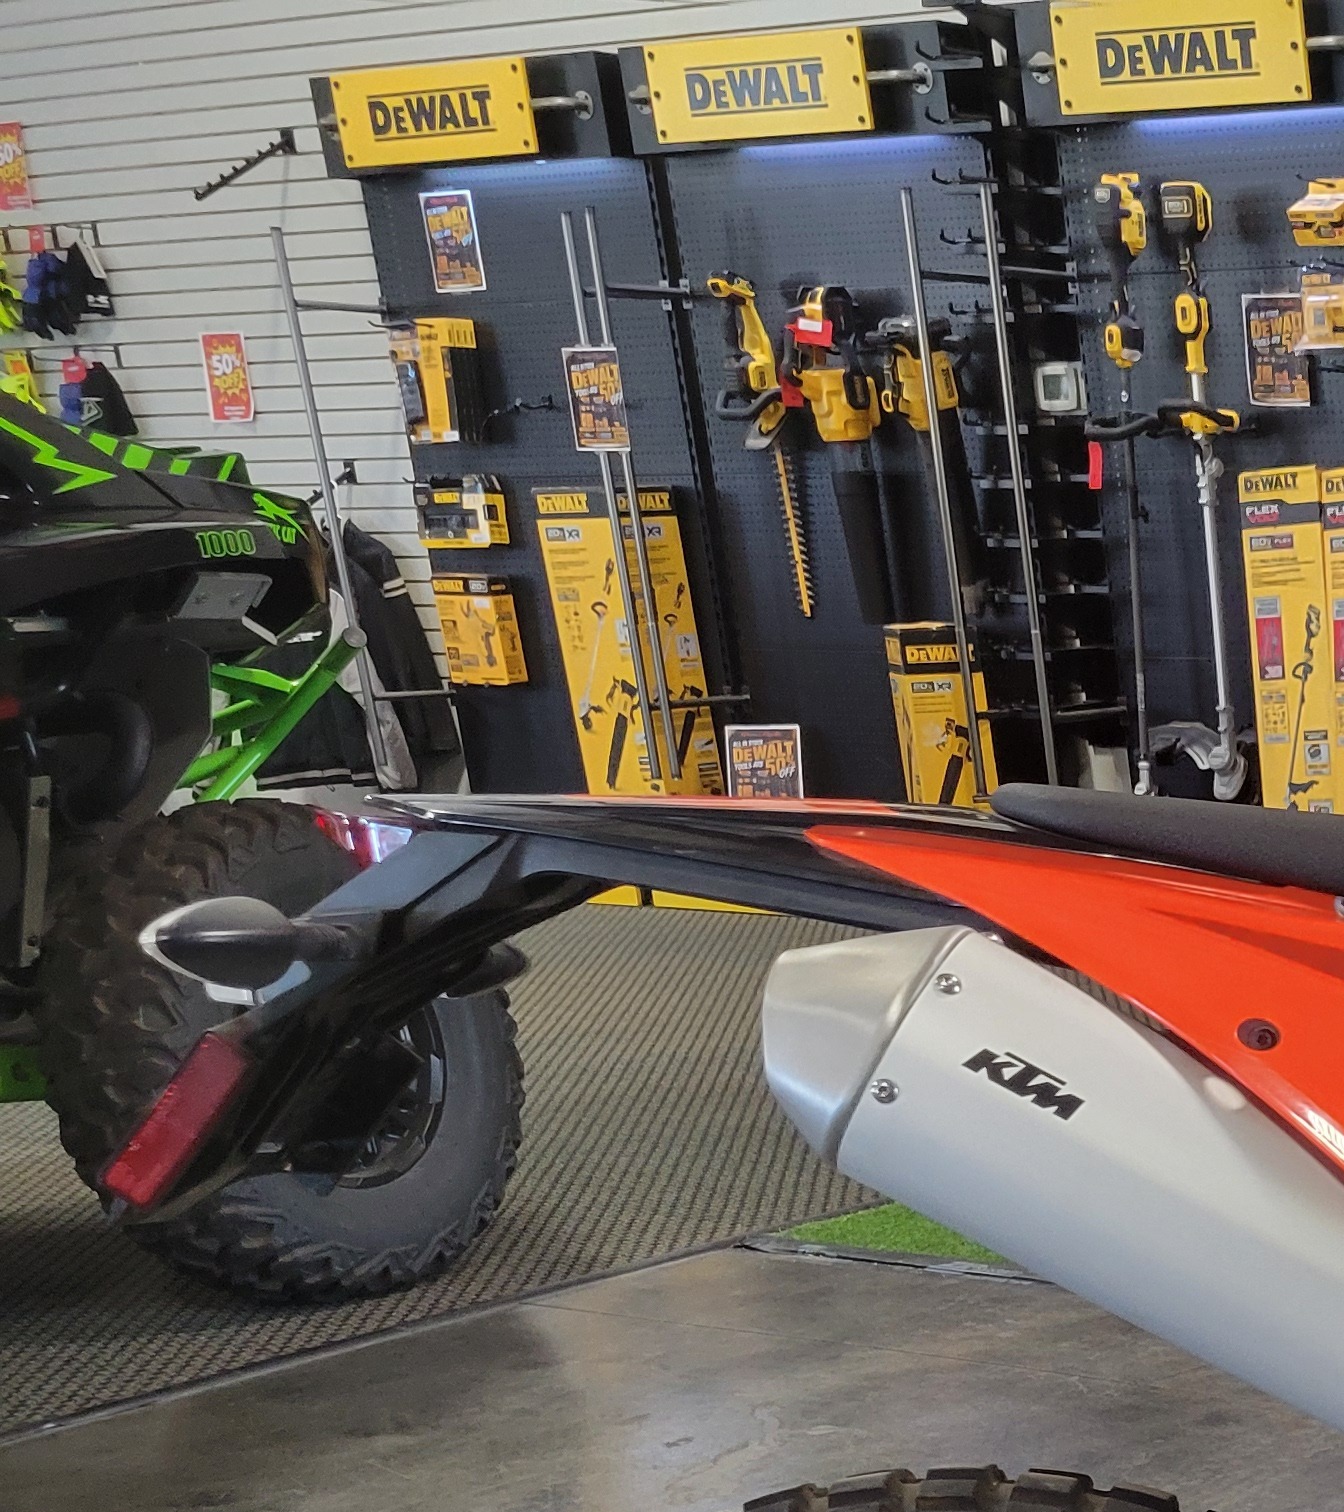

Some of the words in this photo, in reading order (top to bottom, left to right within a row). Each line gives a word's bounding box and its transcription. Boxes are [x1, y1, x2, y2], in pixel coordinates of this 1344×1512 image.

[196, 529, 256, 559] 1000
[733, 741, 794, 764] DEWALT
[961, 1048, 1086, 1121] KTM
